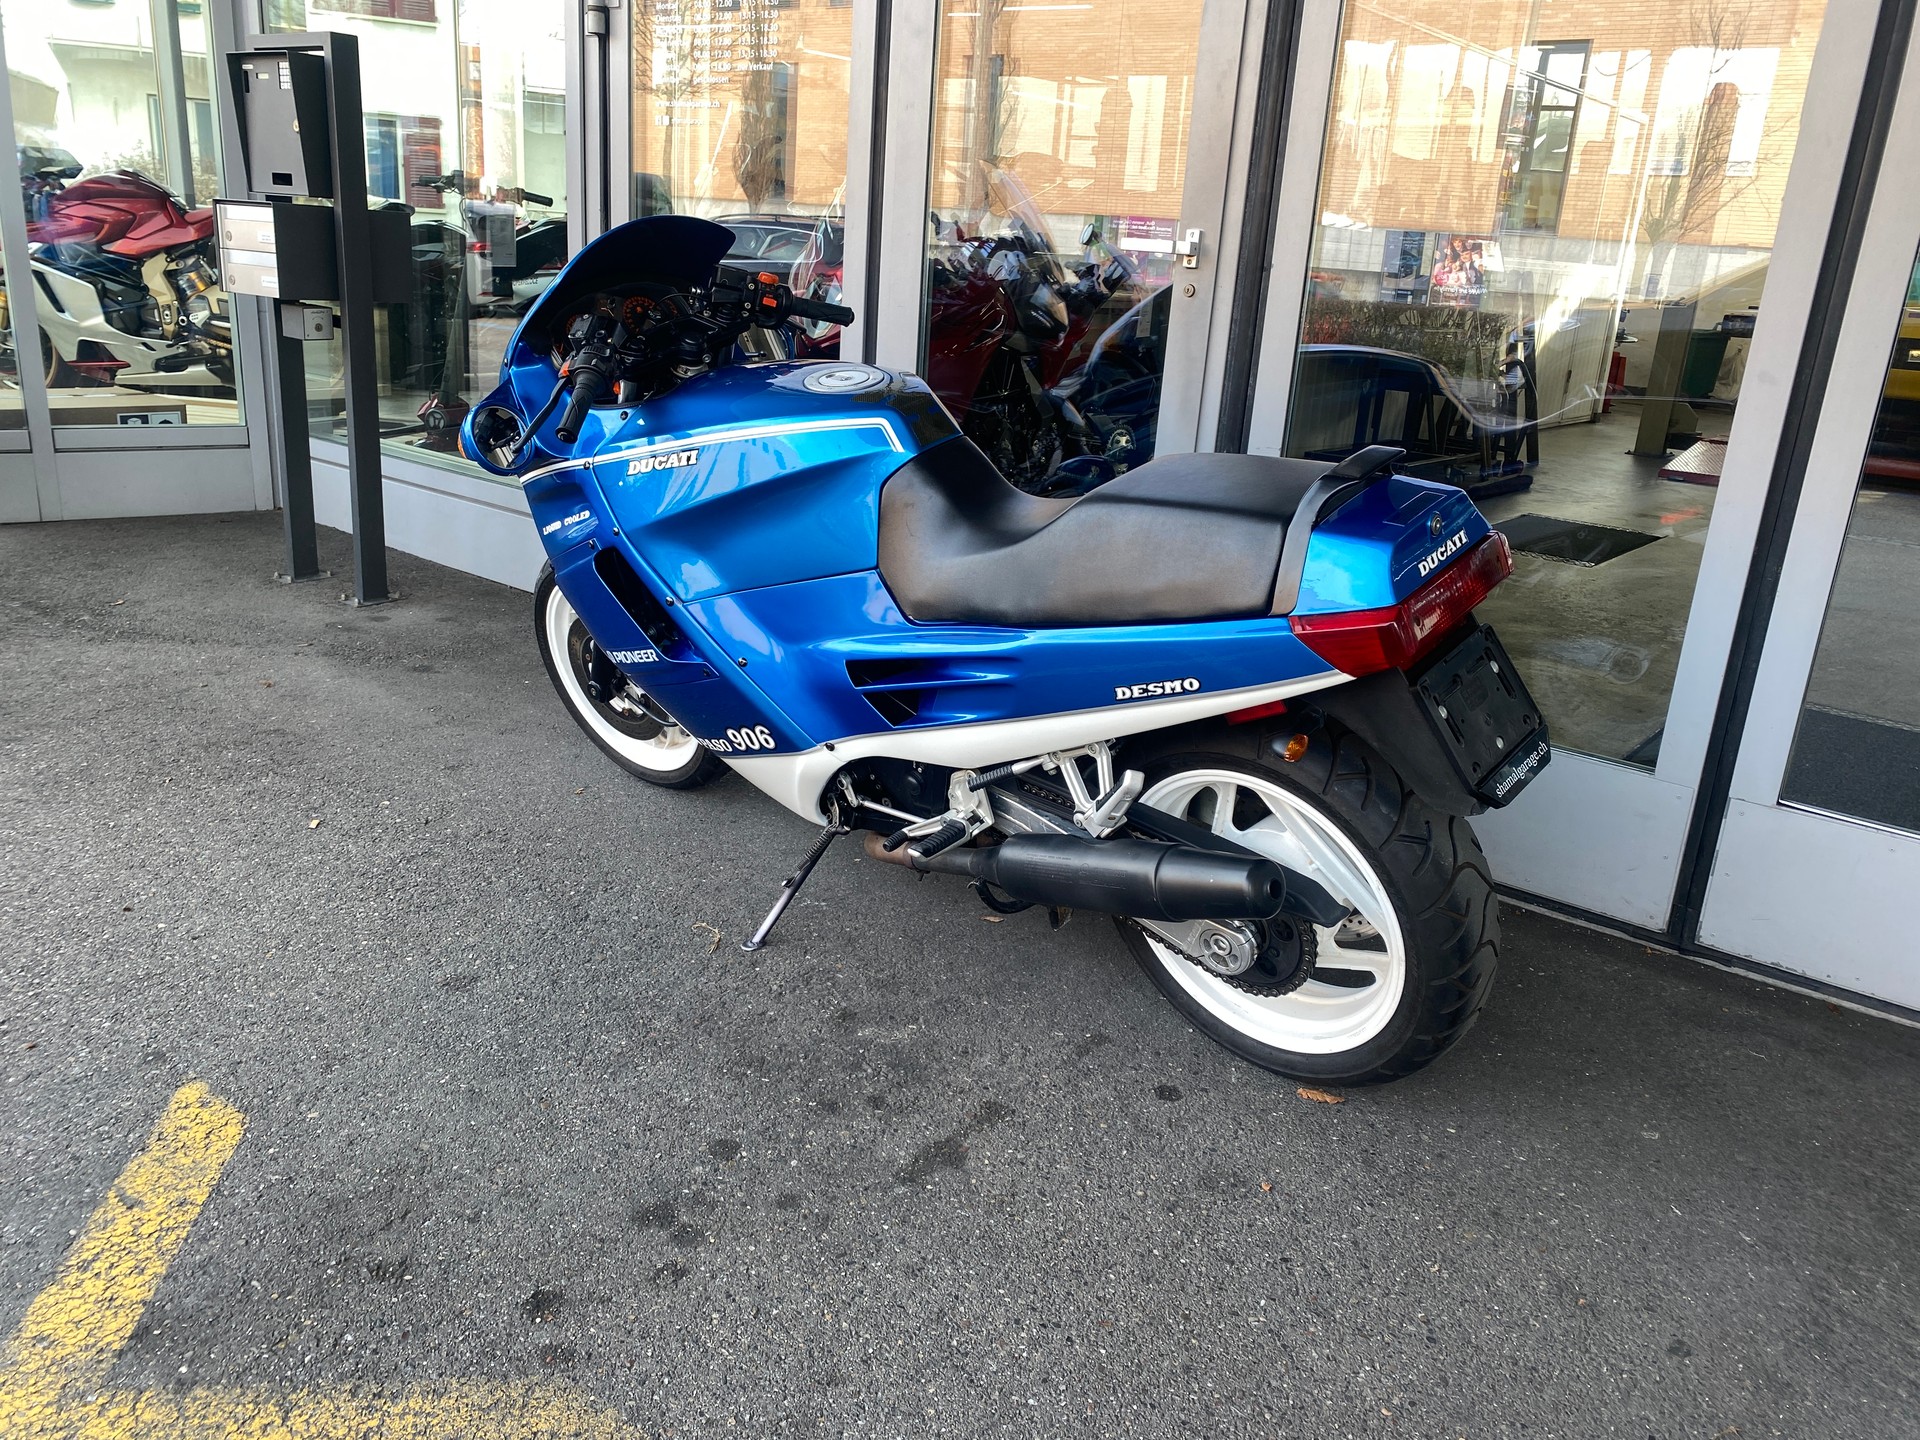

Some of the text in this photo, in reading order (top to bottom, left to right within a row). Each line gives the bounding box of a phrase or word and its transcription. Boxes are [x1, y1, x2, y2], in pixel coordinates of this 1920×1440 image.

[760, 10, 779, 18] 18.30
[760, 23, 779, 32] 18.30
[715, 50, 731, 58] 12.00
[760, 49, 778, 58] 18.30
[749, 61, 774, 71] Verkauf
[626, 449, 700, 477] DUCATI
[564, 509, 591, 526] COOLED
[1417, 527, 1469, 578] DUCATI
[613, 648, 660, 664] PIONEER
[1114, 677, 1201, 700] DESMO
[726, 724, 777, 752] 906
[1495, 741, 1549, 798] shamalgarage.ch
